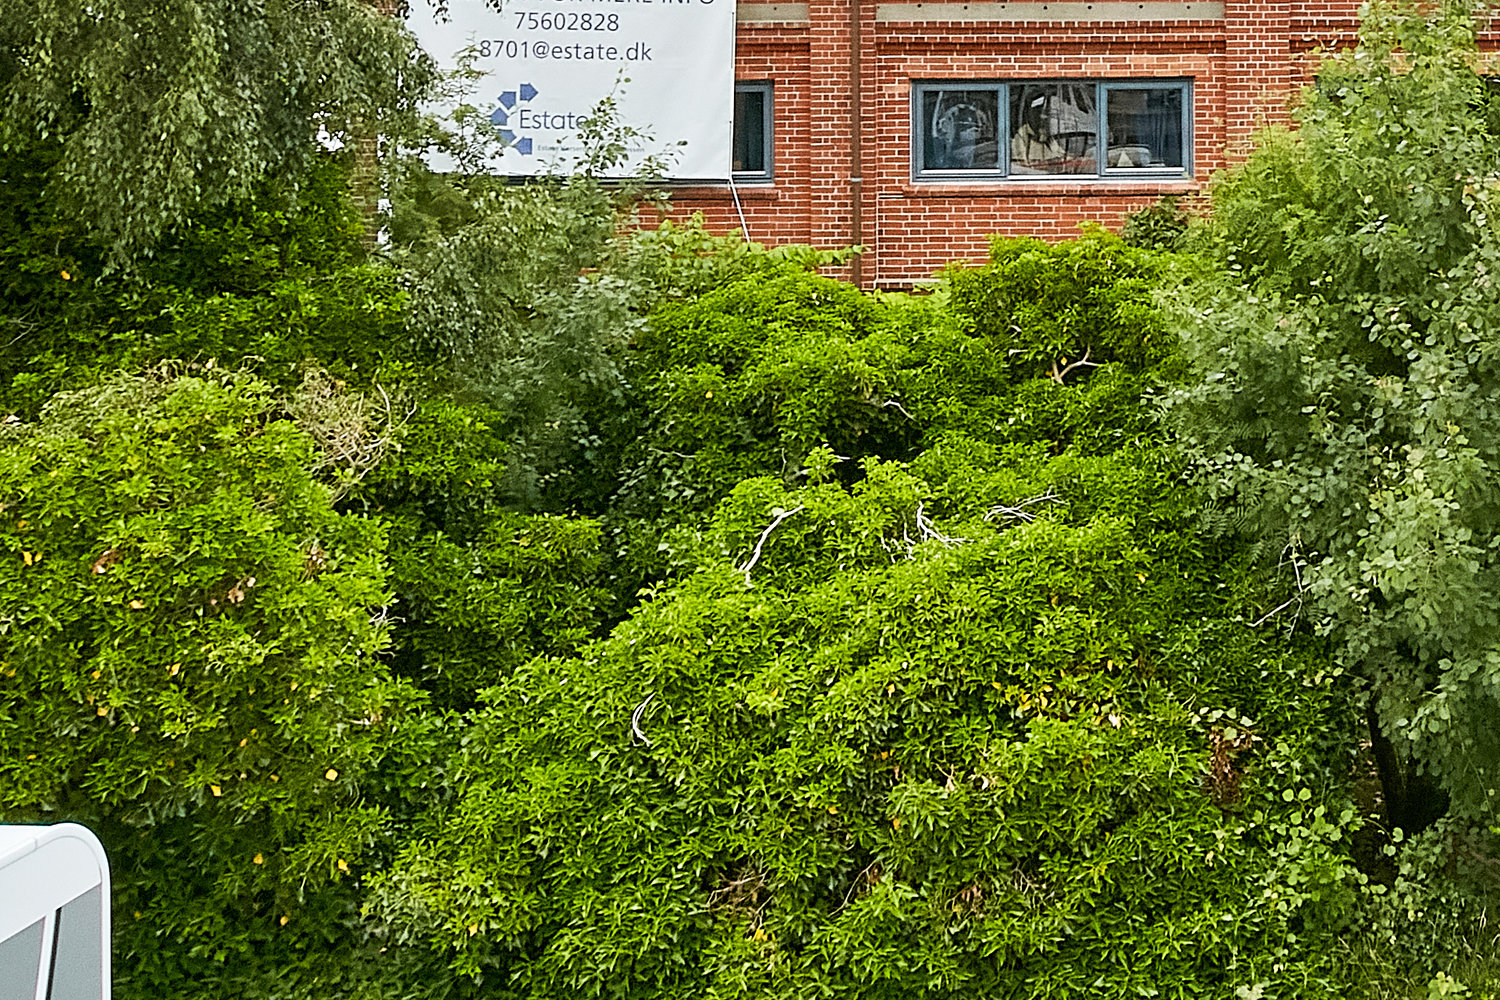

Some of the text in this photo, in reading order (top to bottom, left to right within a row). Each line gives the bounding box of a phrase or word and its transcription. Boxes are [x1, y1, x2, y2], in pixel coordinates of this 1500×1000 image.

[514, 11, 620, 32] 75602828
[480, 39, 652, 61] 8701@estate.dk
[519, 109, 588, 130] Estate
